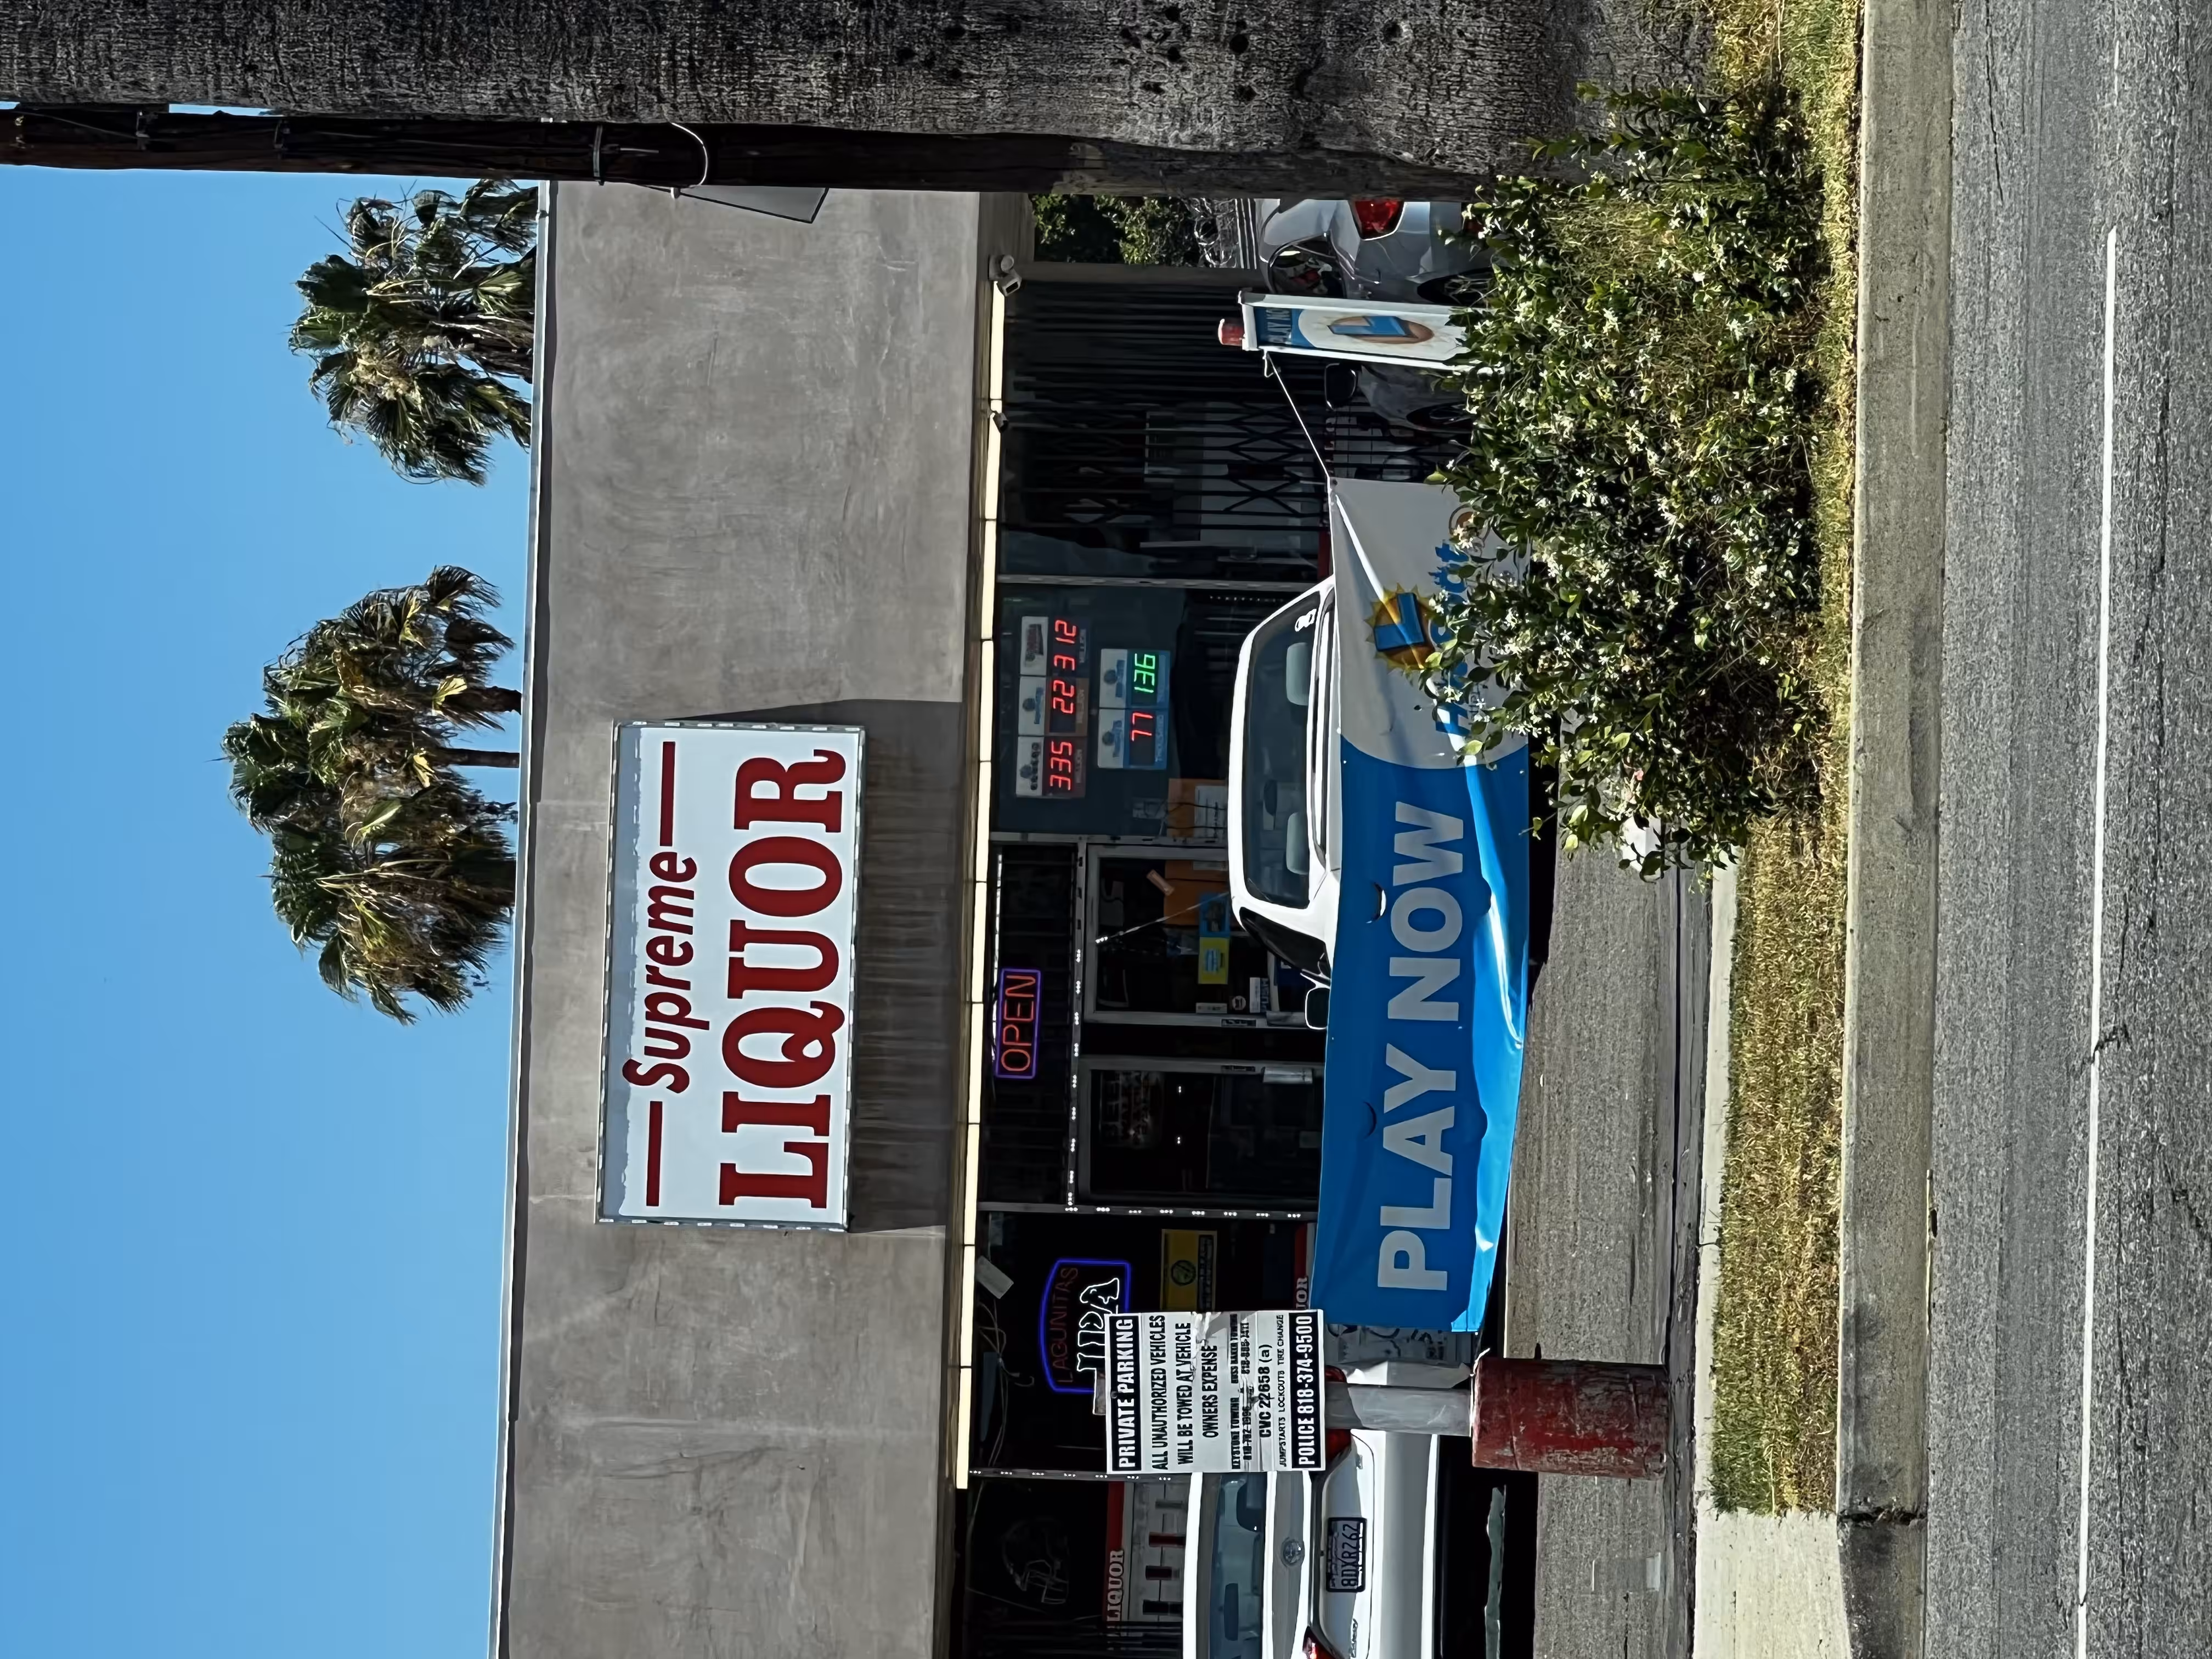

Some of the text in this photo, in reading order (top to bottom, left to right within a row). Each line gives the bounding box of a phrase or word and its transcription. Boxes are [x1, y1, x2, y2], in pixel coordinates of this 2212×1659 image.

[1053, 680, 1075, 714] 22
[1133, 653, 1155, 693] 136
[1049, 741, 1073, 791] 335
[1131, 712, 1153, 741] 77
[1387, 802, 1464, 1022] NOW
[622, 851, 709, 1093] Supreme
[718, 749, 845, 1209] LIQUOR
[1001, 975, 1036, 1071] OPEN
[1377, 1043, 1457, 1291] PLAY
[1049, 1267, 1079, 1383] LAGUNITAS
[1276, 1314, 1284, 1347] CHANGE
[1116, 1319, 1135, 1467] PRIVATE PARKING
[1149, 1315, 1168, 1470] ALL UNAUTHORIZED VEHICLES
[1175, 1323, 1193, 1465] WILL BE TOWED AT VEHICLE
[1201, 1345, 1218, 1438] OWNERS EXPENSE
[1258, 1344, 1273, 1438] CVC 22658 (a)
[1296, 1316, 1315, 1465] POLICE 818-374-9500
[1278, 1417, 1286, 1467] JUMPSTARTS
[1106, 1550, 1124, 1621] LIQUOR
